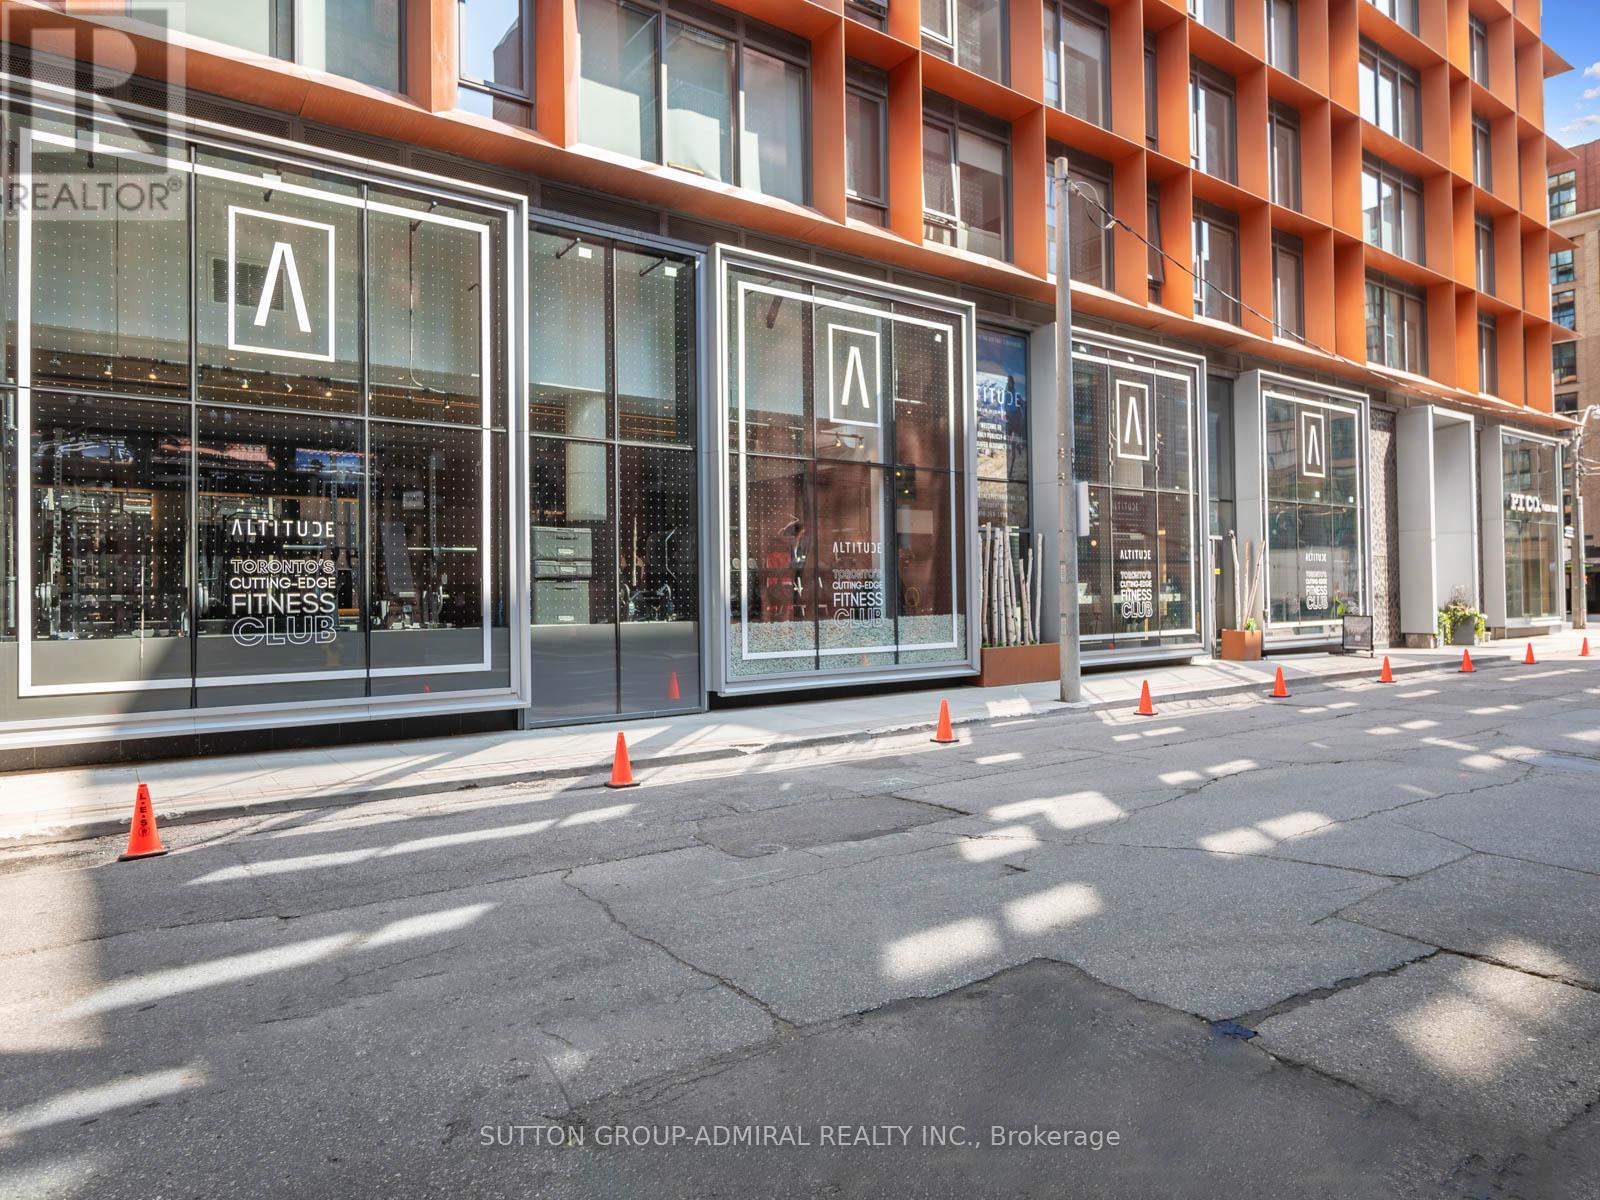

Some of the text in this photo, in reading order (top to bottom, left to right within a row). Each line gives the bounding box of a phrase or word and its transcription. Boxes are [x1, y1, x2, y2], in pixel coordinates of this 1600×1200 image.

[231, 518, 335, 538] ALTITUDE
[832, 541, 883, 554] ALTITUDE
[1120, 549, 1151, 560] ALTITUDE
[230, 559, 336, 574] TORONTO'S
[229, 577, 337, 589] CUTTING-EDGE
[832, 581, 883, 590] CUTTING-EDGE
[833, 592, 884, 607] FITNESS
[1120, 589, 1153, 601] FITNESS
[231, 592, 336, 615] FITNESS
[1121, 601, 1154, 618] CLUB
[833, 607, 885, 629] CLUB
[231, 615, 337, 647] CLUB
